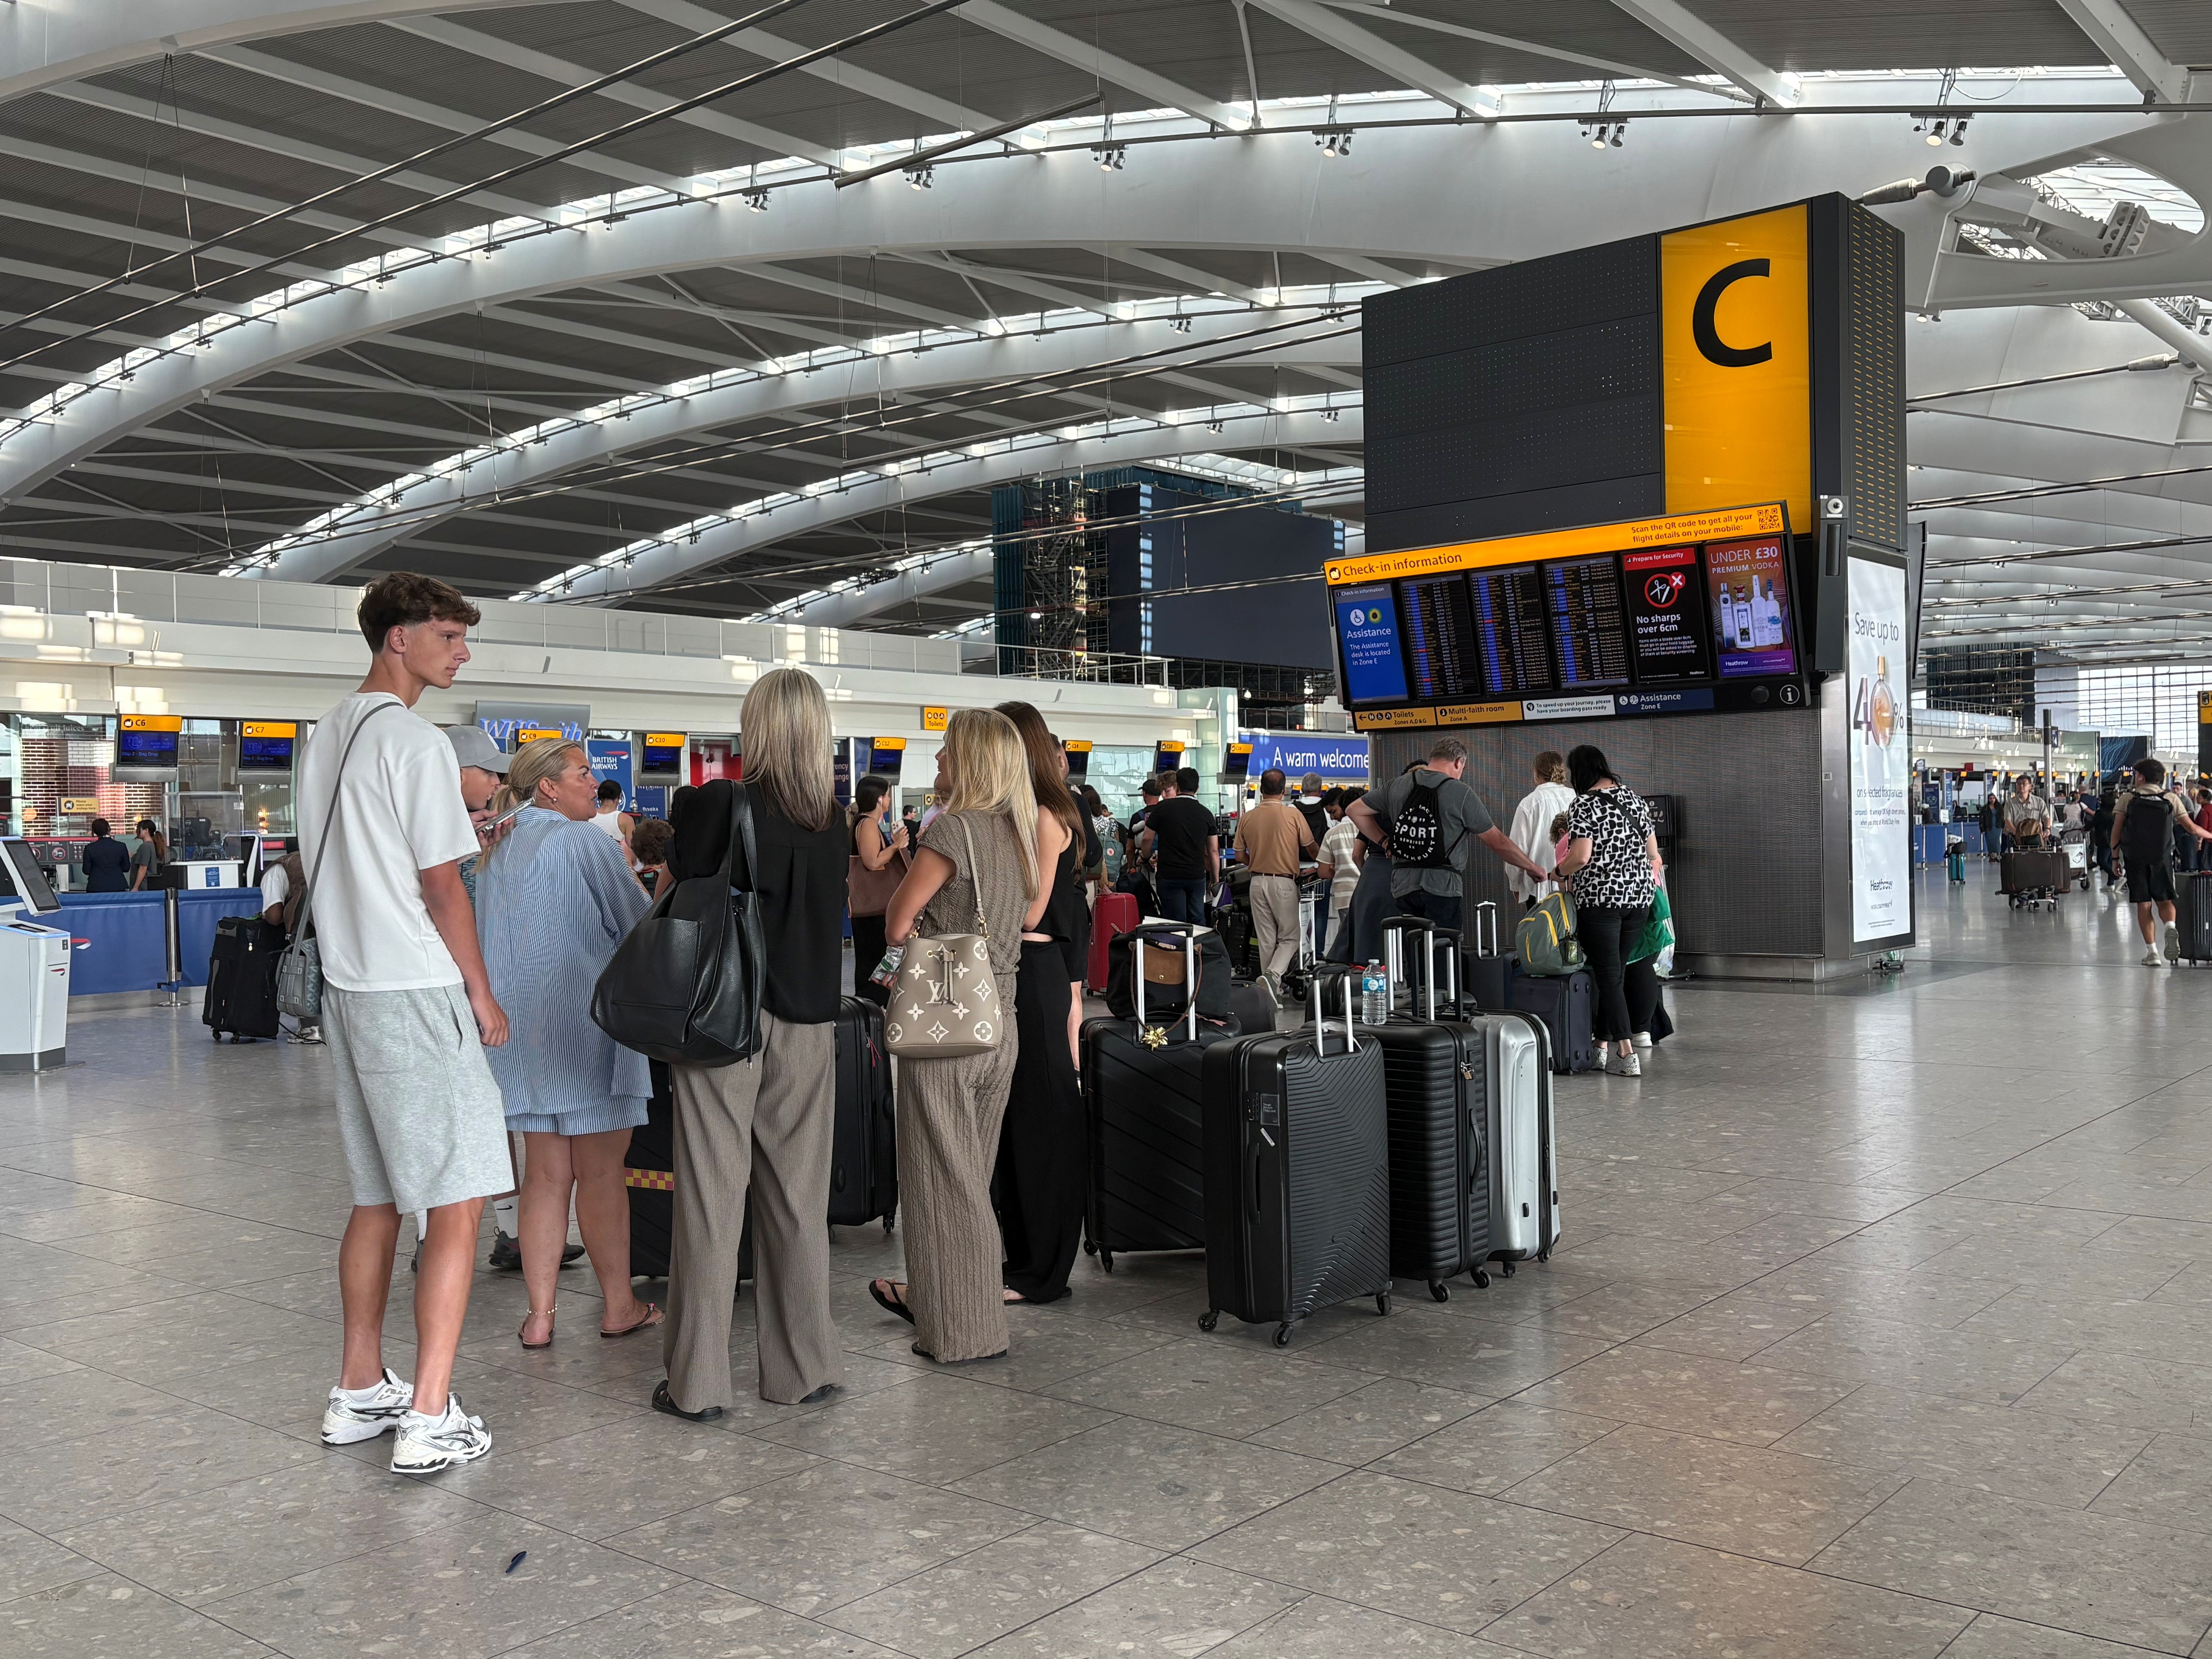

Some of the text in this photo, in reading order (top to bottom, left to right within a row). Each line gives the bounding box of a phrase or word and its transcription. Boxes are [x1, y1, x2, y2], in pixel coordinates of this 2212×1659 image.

[1692, 258, 1772, 367] C
[1708, 517, 1721, 526] get
[1735, 514, 1753, 523] your
[1633, 535, 1653, 543] flight
[1655, 531, 1680, 540] details
[1694, 528, 1712, 537] your
[1714, 525, 1743, 533] mobile:
[1711, 546, 1778, 563] UNDER £30
[1343, 553, 1462, 576] Check-in information
[1712, 564, 1748, 574] PREMIUM
[1636, 614, 1681, 624] No sharps
[1347, 628, 1391, 639] Assistance
[1637, 626, 1658, 634] over
[1855, 612, 1899, 645] Save up to
[1640, 694, 1681, 702] Assistance
[1449, 706, 1485, 715] Multi-faith
[480, 719, 583, 741] WHSth
[1273, 746, 1369, 768] A warm welcome
[1395, 822, 1437, 838] SPORT
